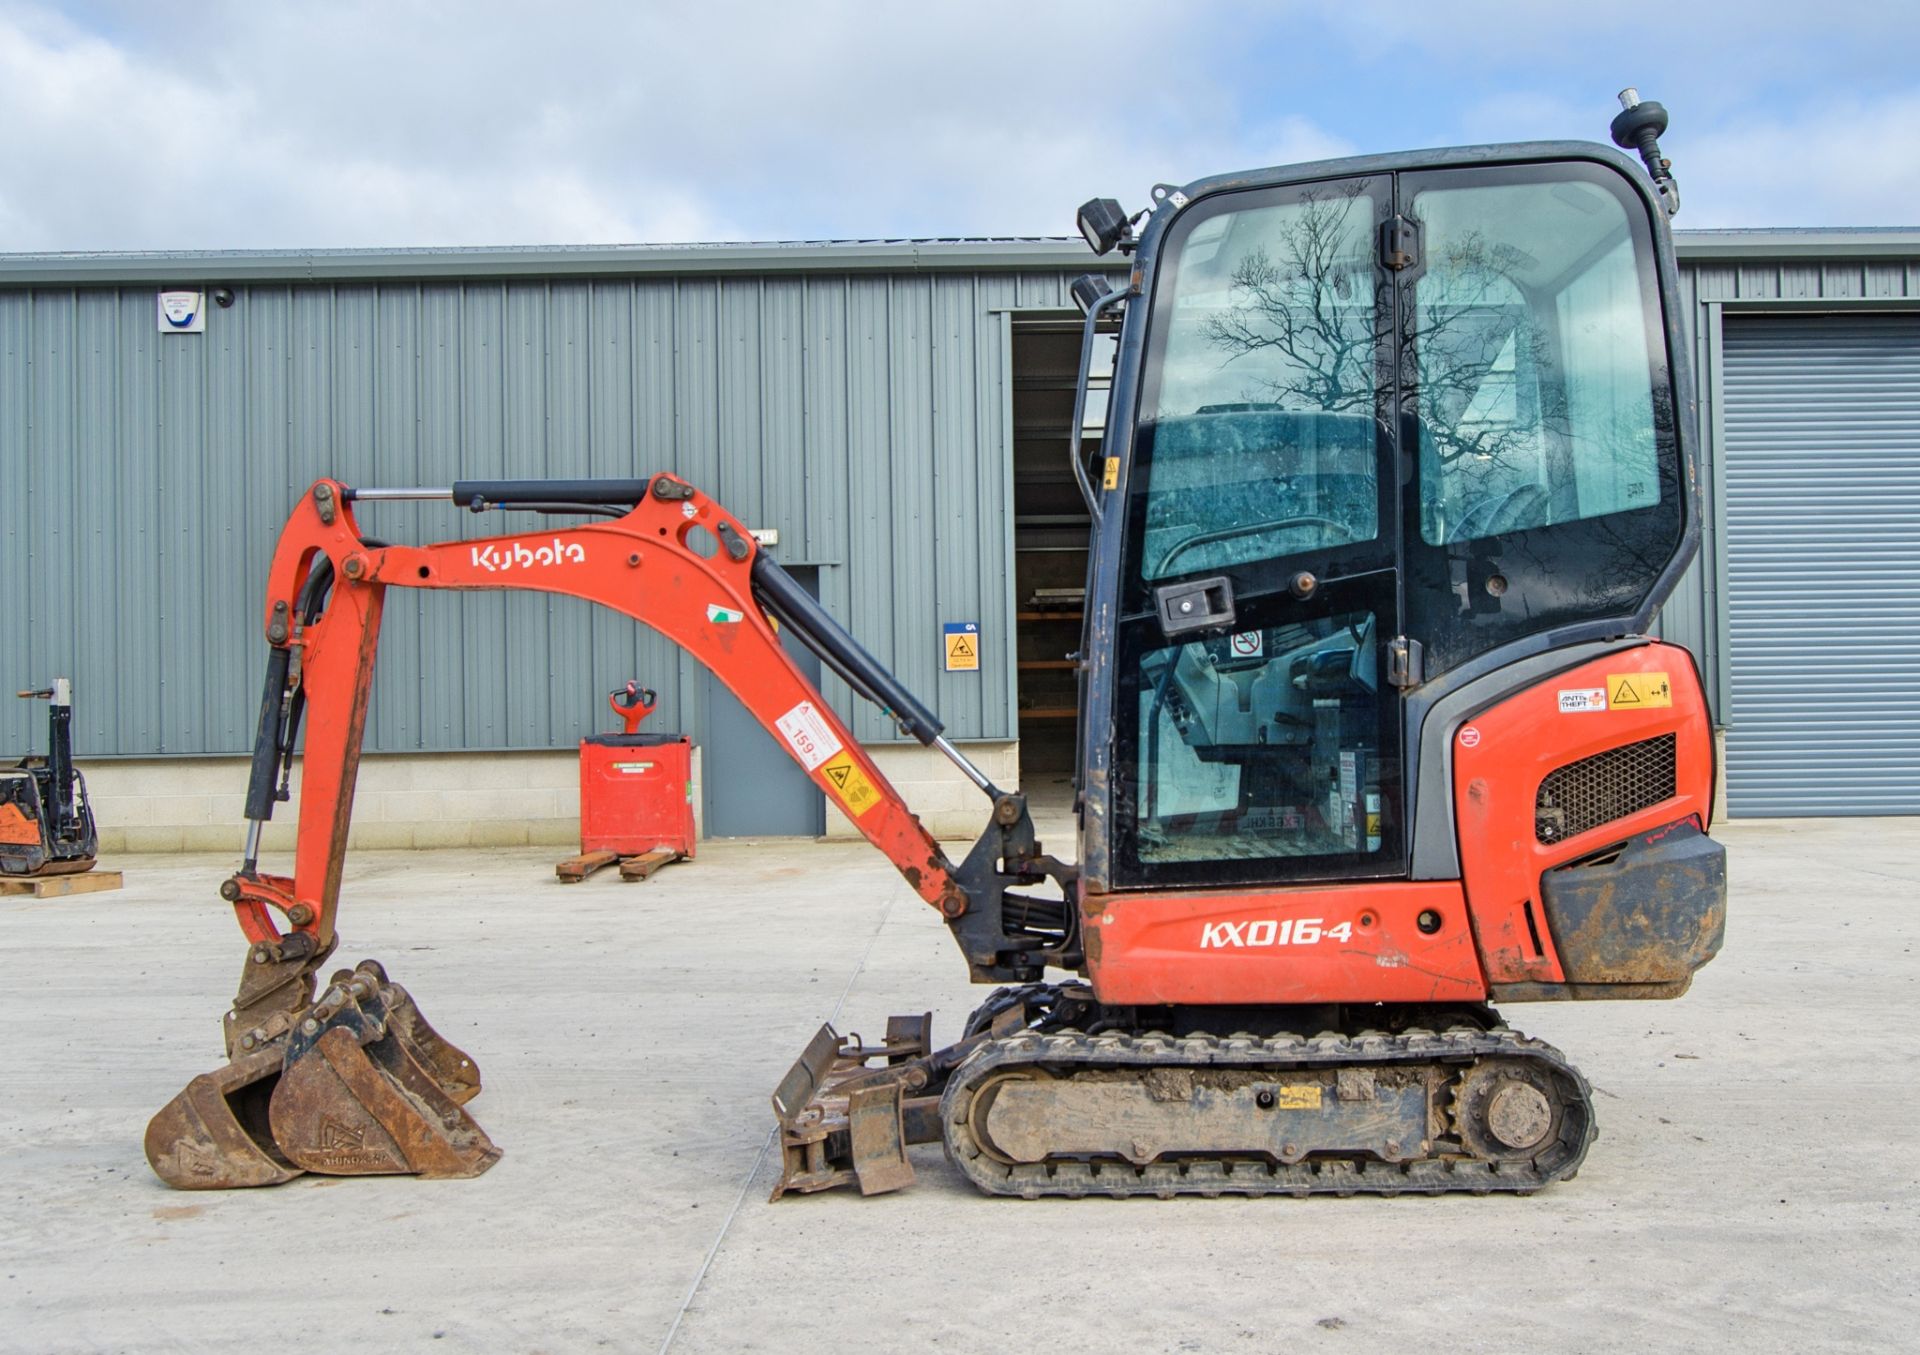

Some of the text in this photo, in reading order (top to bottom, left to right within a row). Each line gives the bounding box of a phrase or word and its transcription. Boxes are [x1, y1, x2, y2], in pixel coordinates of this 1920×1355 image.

[471, 538, 585, 572] Kubota
[793, 728, 815, 754] 159
[1200, 918, 1352, 948] KX016-4
